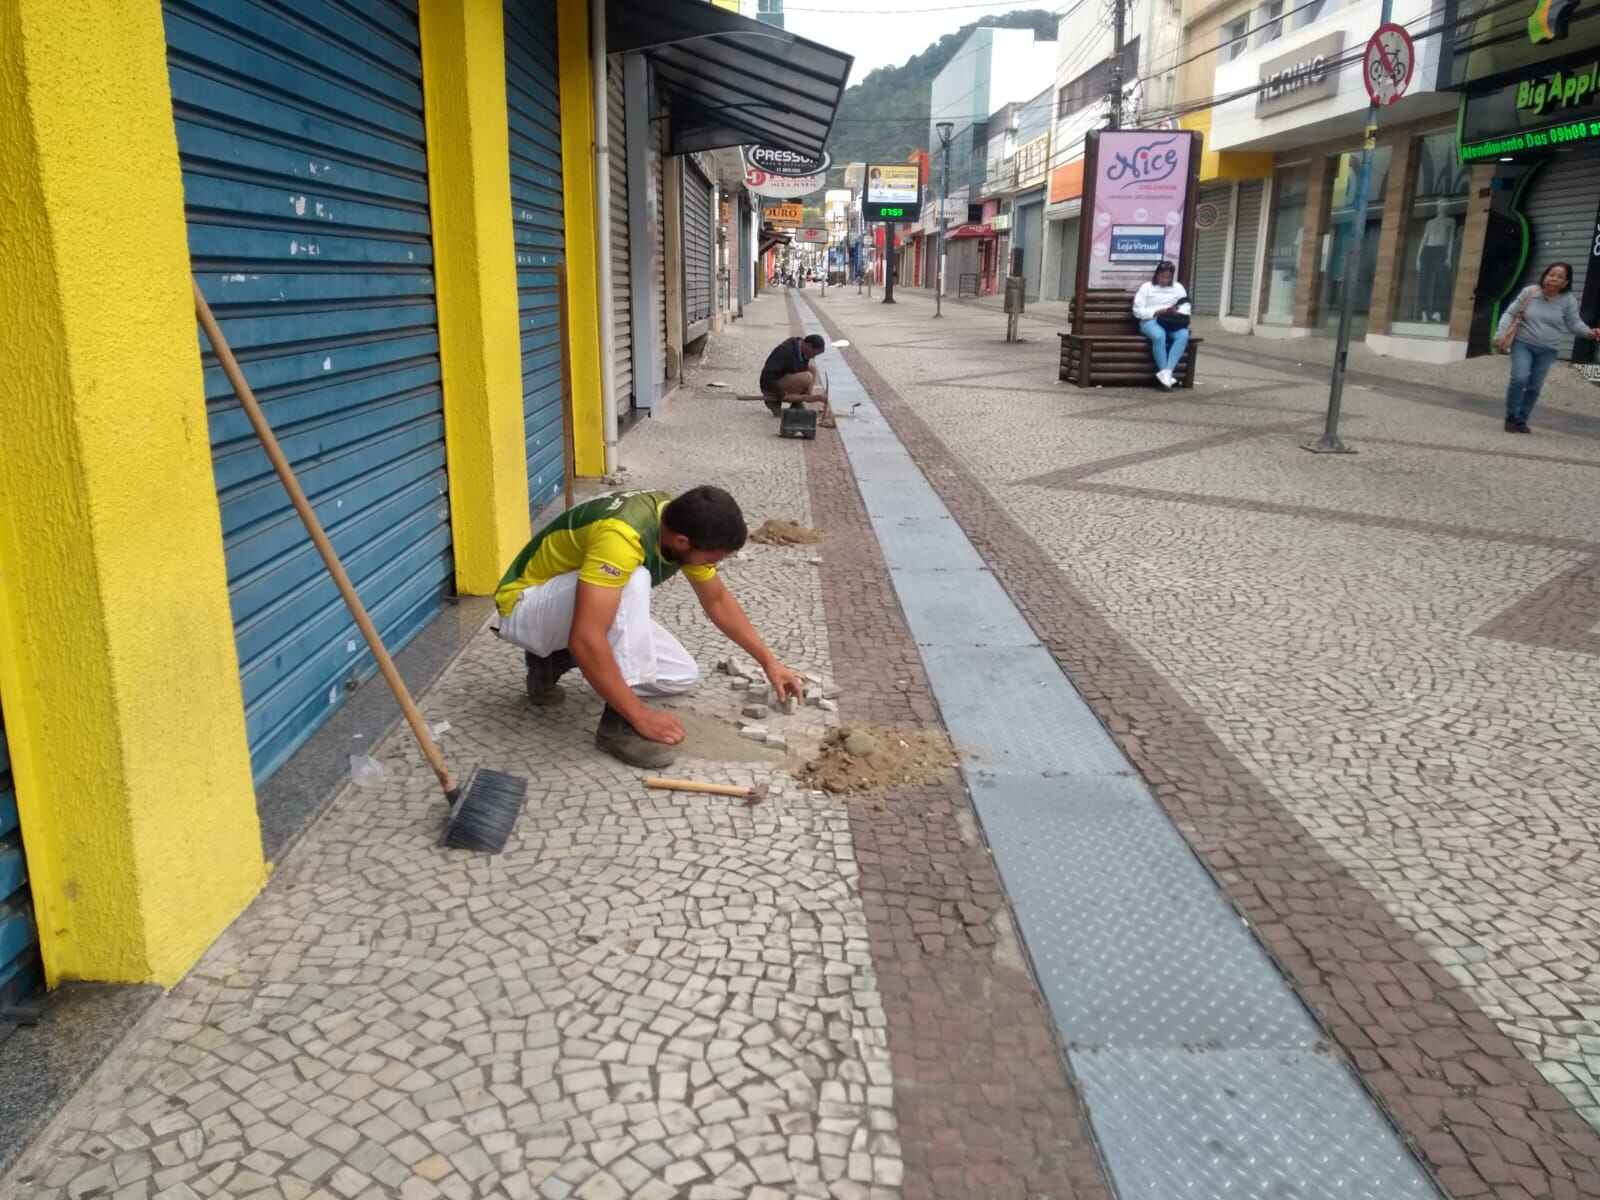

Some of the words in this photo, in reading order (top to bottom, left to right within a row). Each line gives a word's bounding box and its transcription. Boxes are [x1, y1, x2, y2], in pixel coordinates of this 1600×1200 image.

[1258, 54, 1328, 102] HERING
[1516, 79, 1546, 114] Big
[1547, 62, 1600, 107] Appl
[1551, 122, 1587, 144] 09h00
[1107, 143, 1178, 182] Nice
